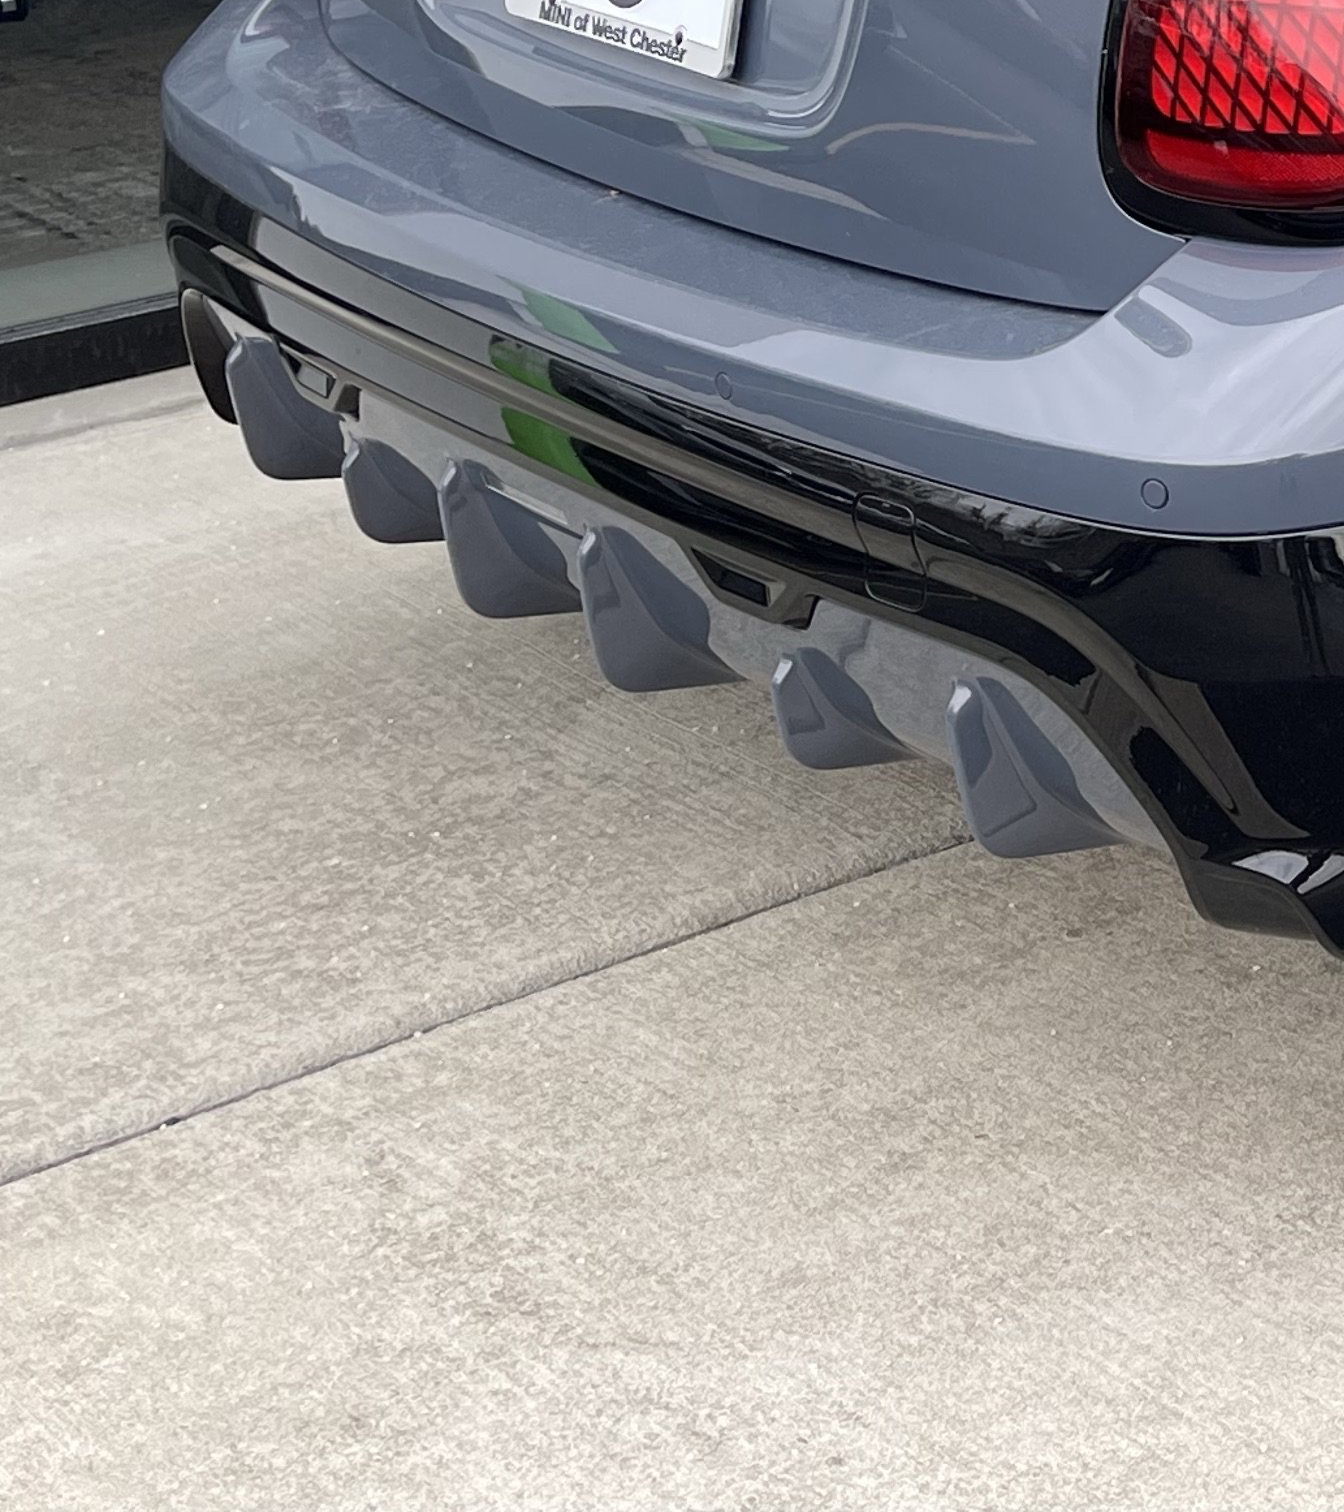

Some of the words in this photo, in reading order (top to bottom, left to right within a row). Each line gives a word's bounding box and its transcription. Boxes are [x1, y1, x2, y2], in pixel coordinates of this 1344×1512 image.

[539, 0, 572, 29] MINI
[573, 12, 591, 33] of
[591, 14, 628, 44] West
[629, 28, 687, 63] Chester
